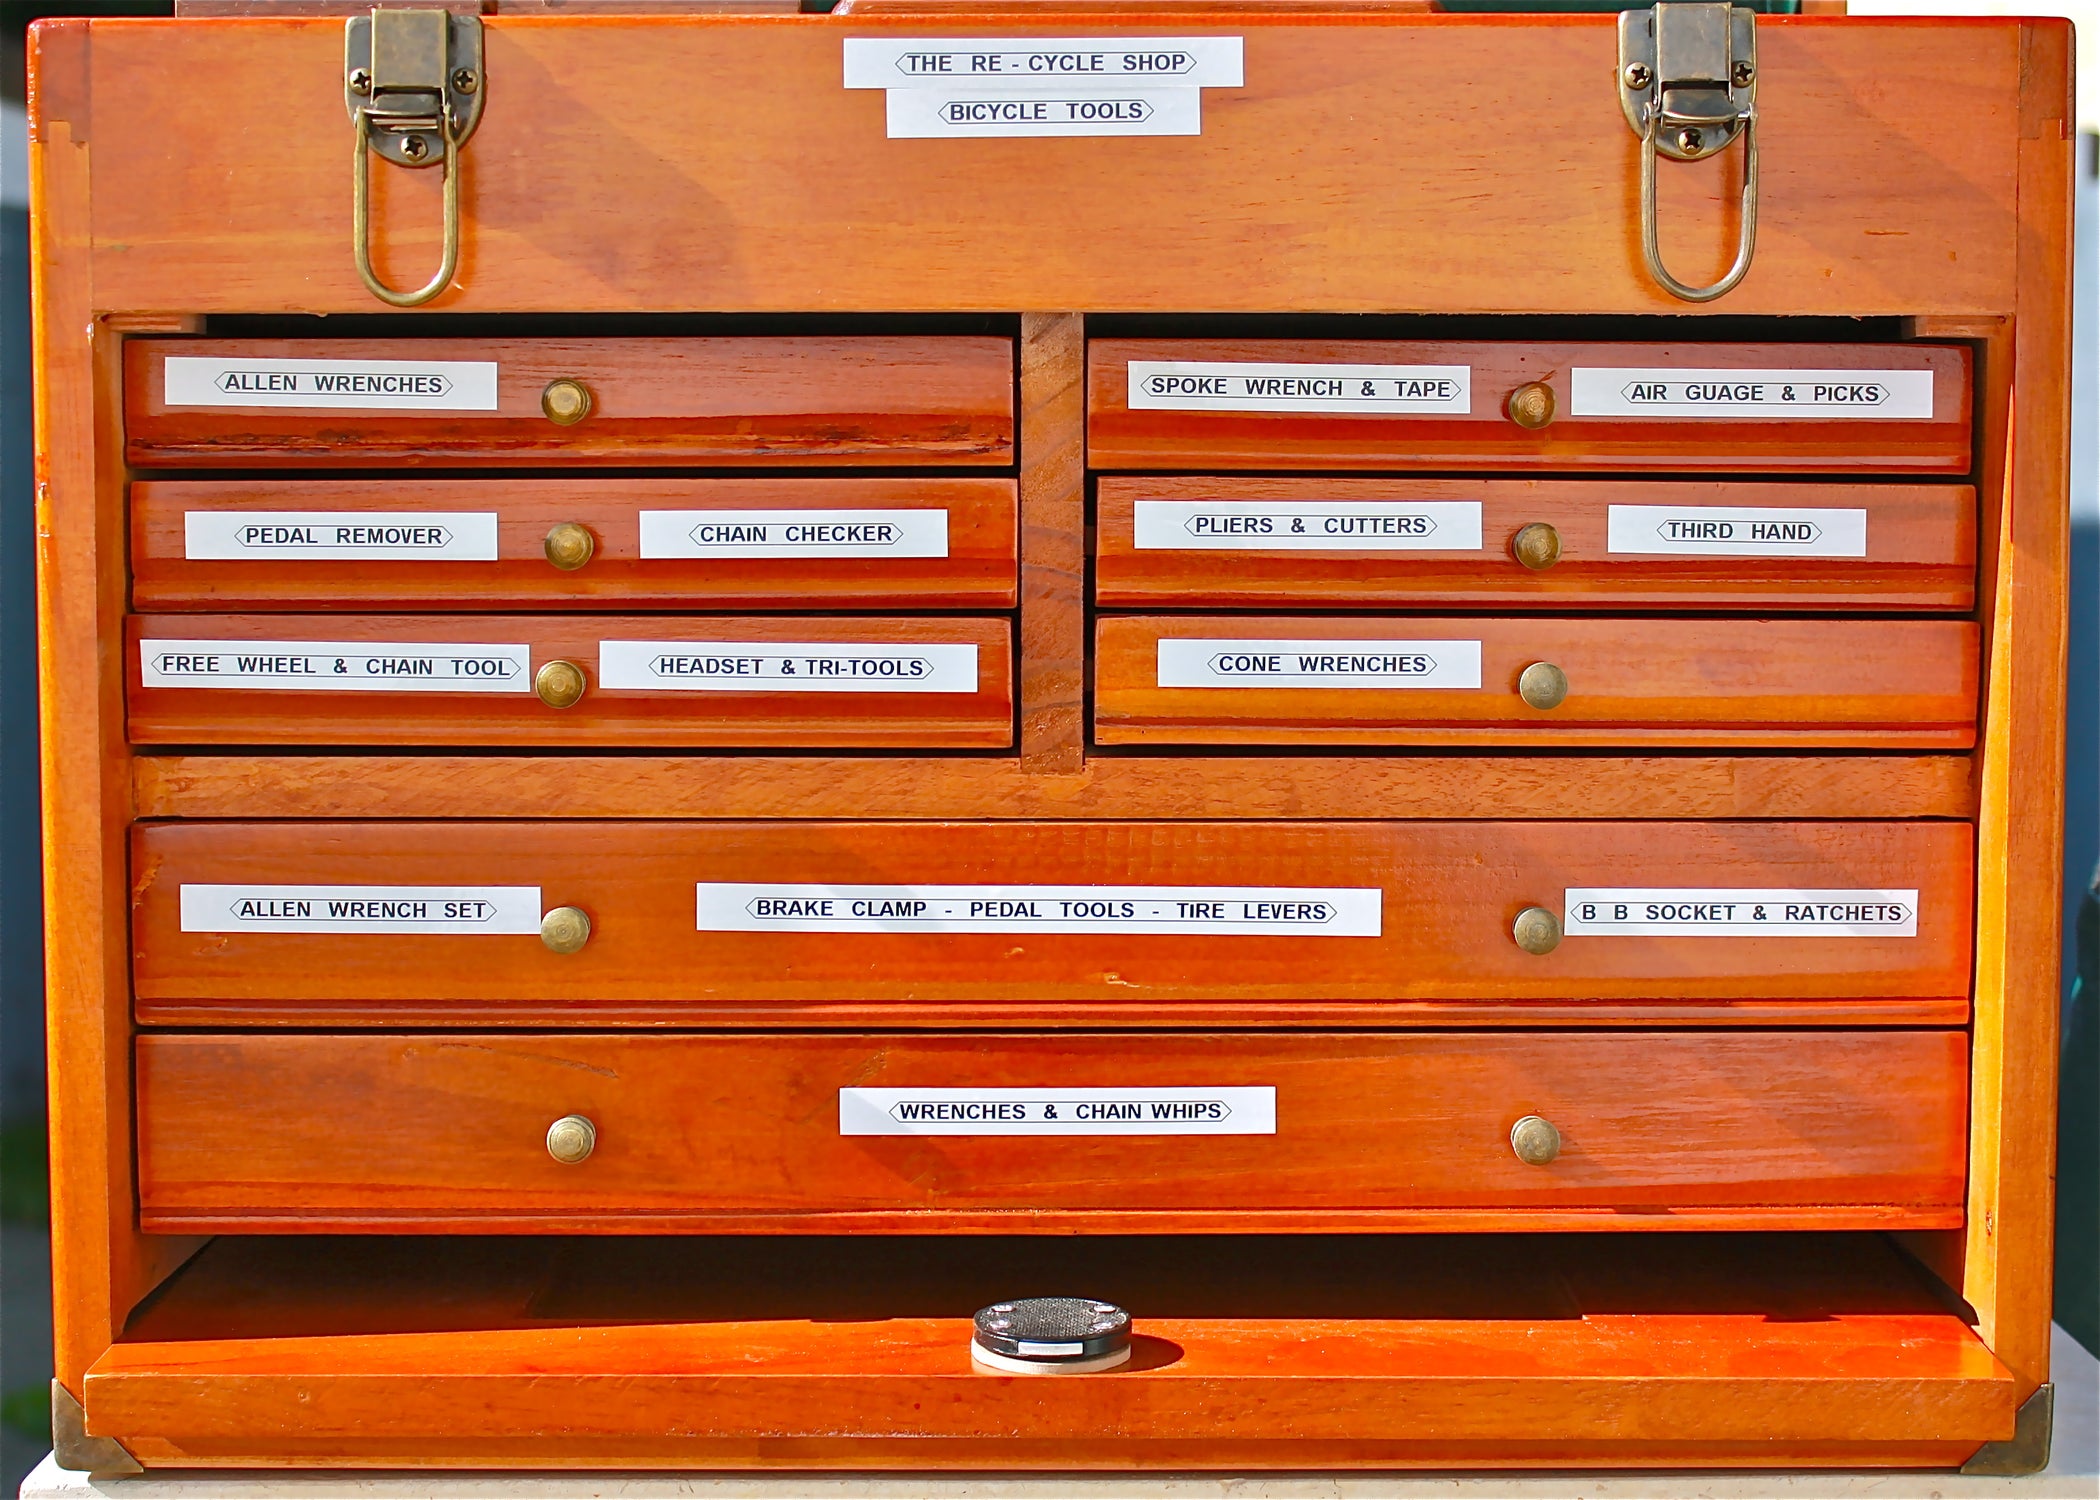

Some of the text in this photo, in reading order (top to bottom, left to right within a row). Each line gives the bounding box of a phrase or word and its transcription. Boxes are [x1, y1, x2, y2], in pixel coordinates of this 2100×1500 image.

[908, 55, 952, 71] THE
[972, 55, 1002, 71] RE
[1028, 54, 1104, 71] CYCLE
[1123, 54, 1187, 71] SHOP
[949, 101, 1143, 119] BICYCLE TOOLS
[225, 374, 442, 393] ALLEN WRENCHES
[1151, 378, 1450, 398] SPOKE WRENCH & TAPE
[1630, 385, 1879, 402] AIR GUAGE & PICKS
[700, 525, 893, 542] CHAIN CHECKER
[1196, 516, 1427, 534] PLIERS & CUTTERS
[1668, 522, 1813, 540] THIRD HAND
[246, 527, 443, 544] PEDAL REMOVER
[163, 654, 510, 675] FREE WHEEL & CHAIN TOOL
[660, 657, 924, 676] HEADSET & TRI-TOOLS
[1219, 655, 1426, 672] CONE WRENCHES
[240, 900, 487, 918] ALLEN WRENCH SET
[757, 898, 834, 915] BRAKE
[852, 899, 928, 916] CLAMP
[970, 901, 1042, 918] PEDAL
[1059, 901, 1135, 918] TOOLS
[1176, 902, 1225, 919] TIRE
[1243, 903, 1328, 920] LEVERS
[1582, 904, 1903, 920] B B SOCKET & RATCHETS
[899, 1103, 1221, 1120] WRENCHES & CHAIN WHIPS
